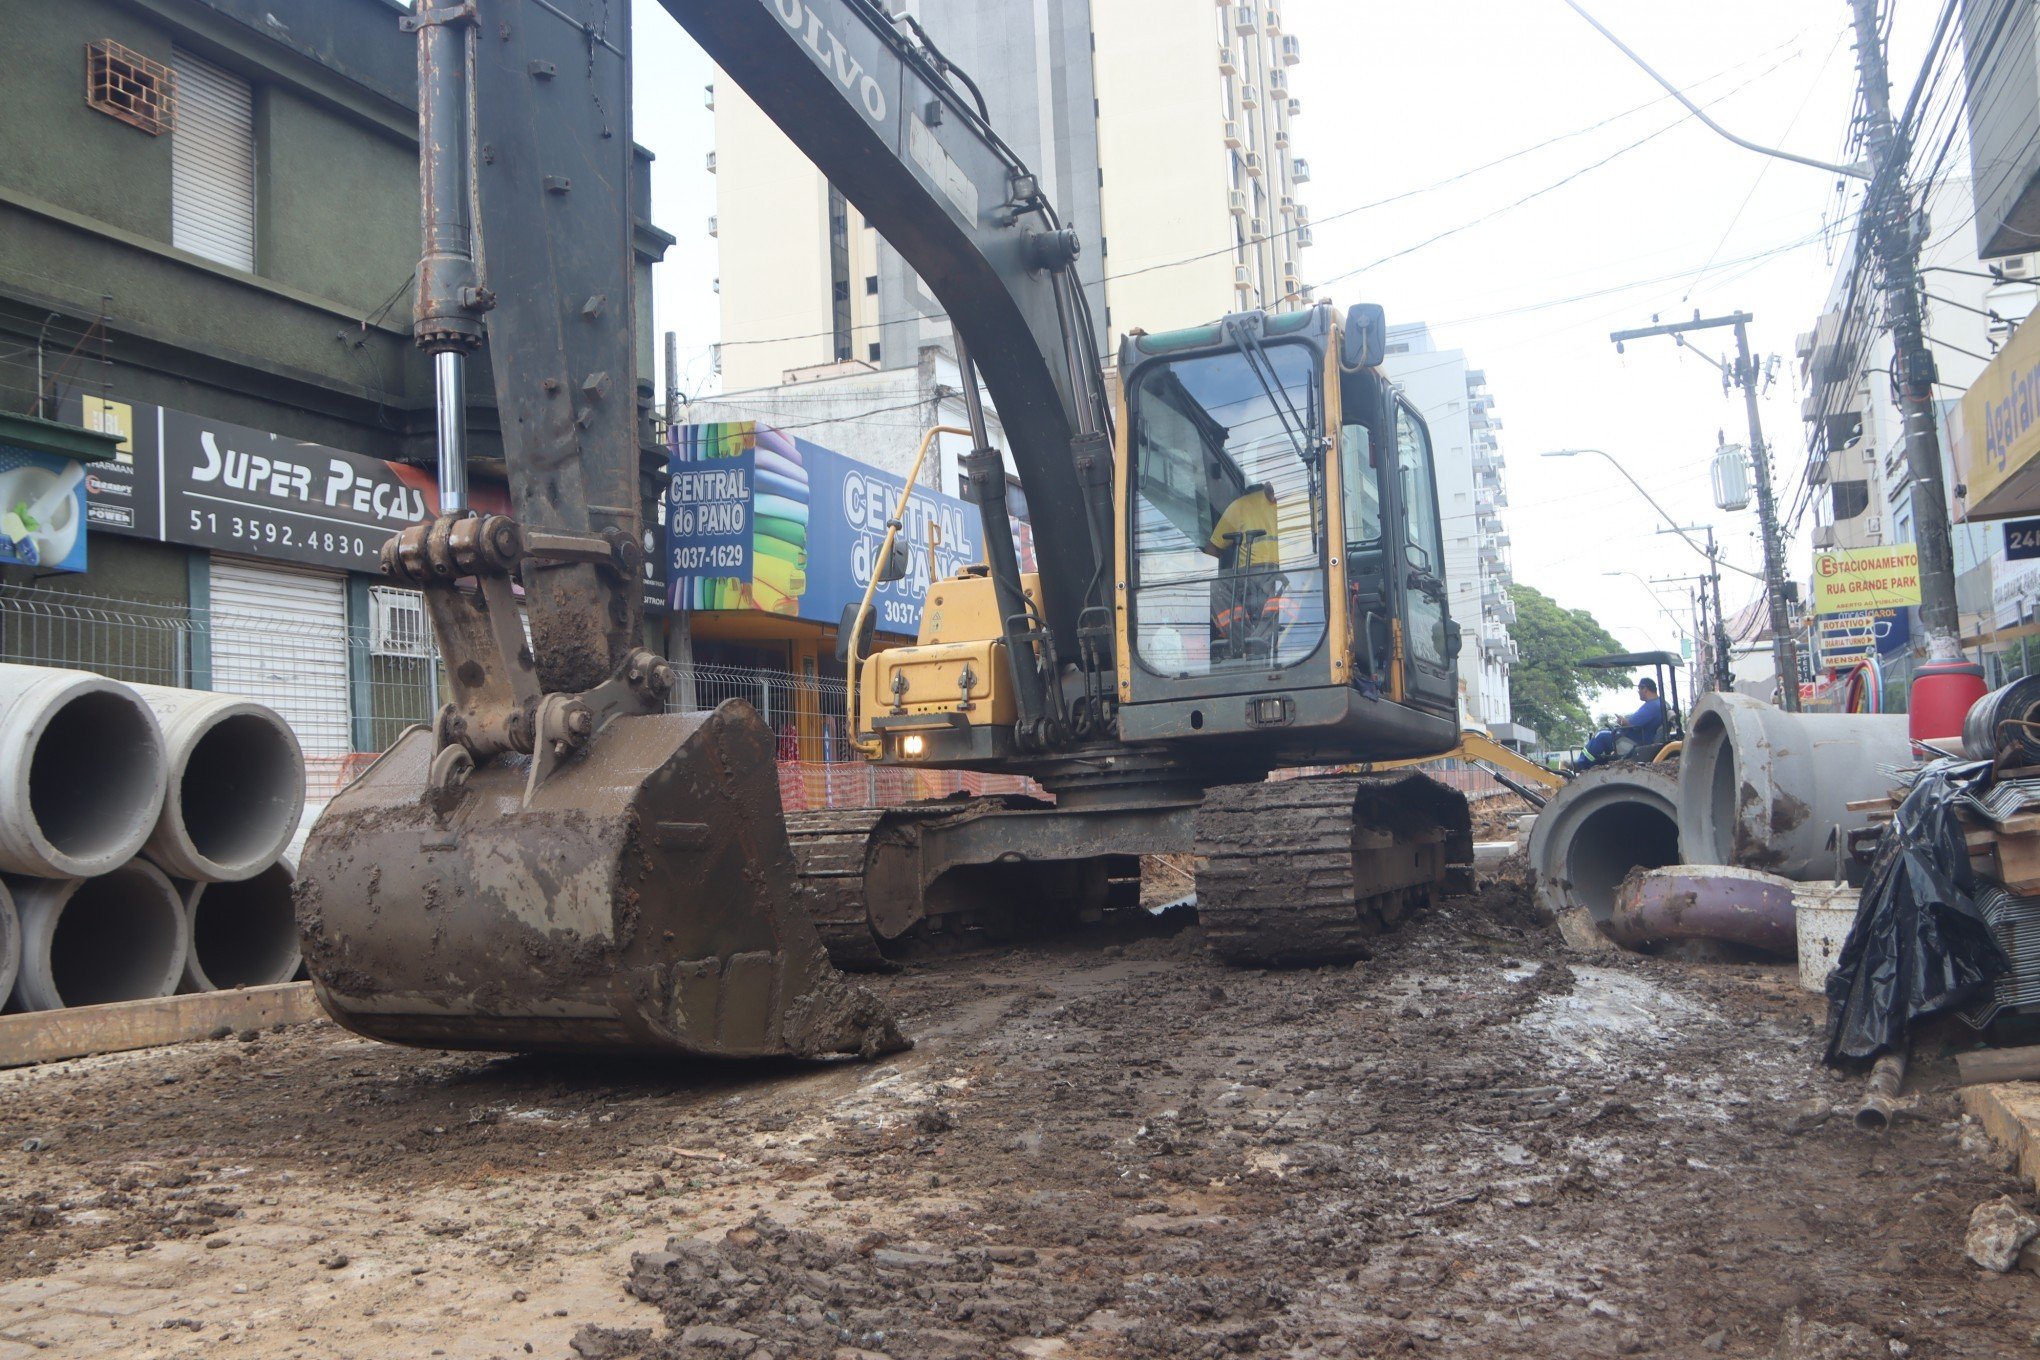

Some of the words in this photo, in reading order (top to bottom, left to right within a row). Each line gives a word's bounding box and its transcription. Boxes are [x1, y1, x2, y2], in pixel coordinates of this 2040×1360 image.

[190, 430, 313, 502] SUPER
[324, 458, 426, 522] PEÇAS
[670, 469, 750, 504] CENTRAL
[88, 509, 131, 522] POWER
[673, 506, 694, 535] do
[698, 501, 745, 533] PANO
[189, 509, 218, 534] 51
[231, 516, 365, 557] 3592.4830
[673, 544, 744, 570] 3037-1629
[1821, 554, 1918, 575] ESTACIONAMENTO
[1826, 583, 1847, 595] RUA
[1848, 578, 1889, 593] GRANDE
[1891, 576, 1917, 589] PARK
[1836, 601, 1863, 609] ABERTO
[1867, 608, 1897, 618] CAROL
[1823, 619, 1864, 630] ROTATIVO
[1845, 636, 1866, 646] TURNO
